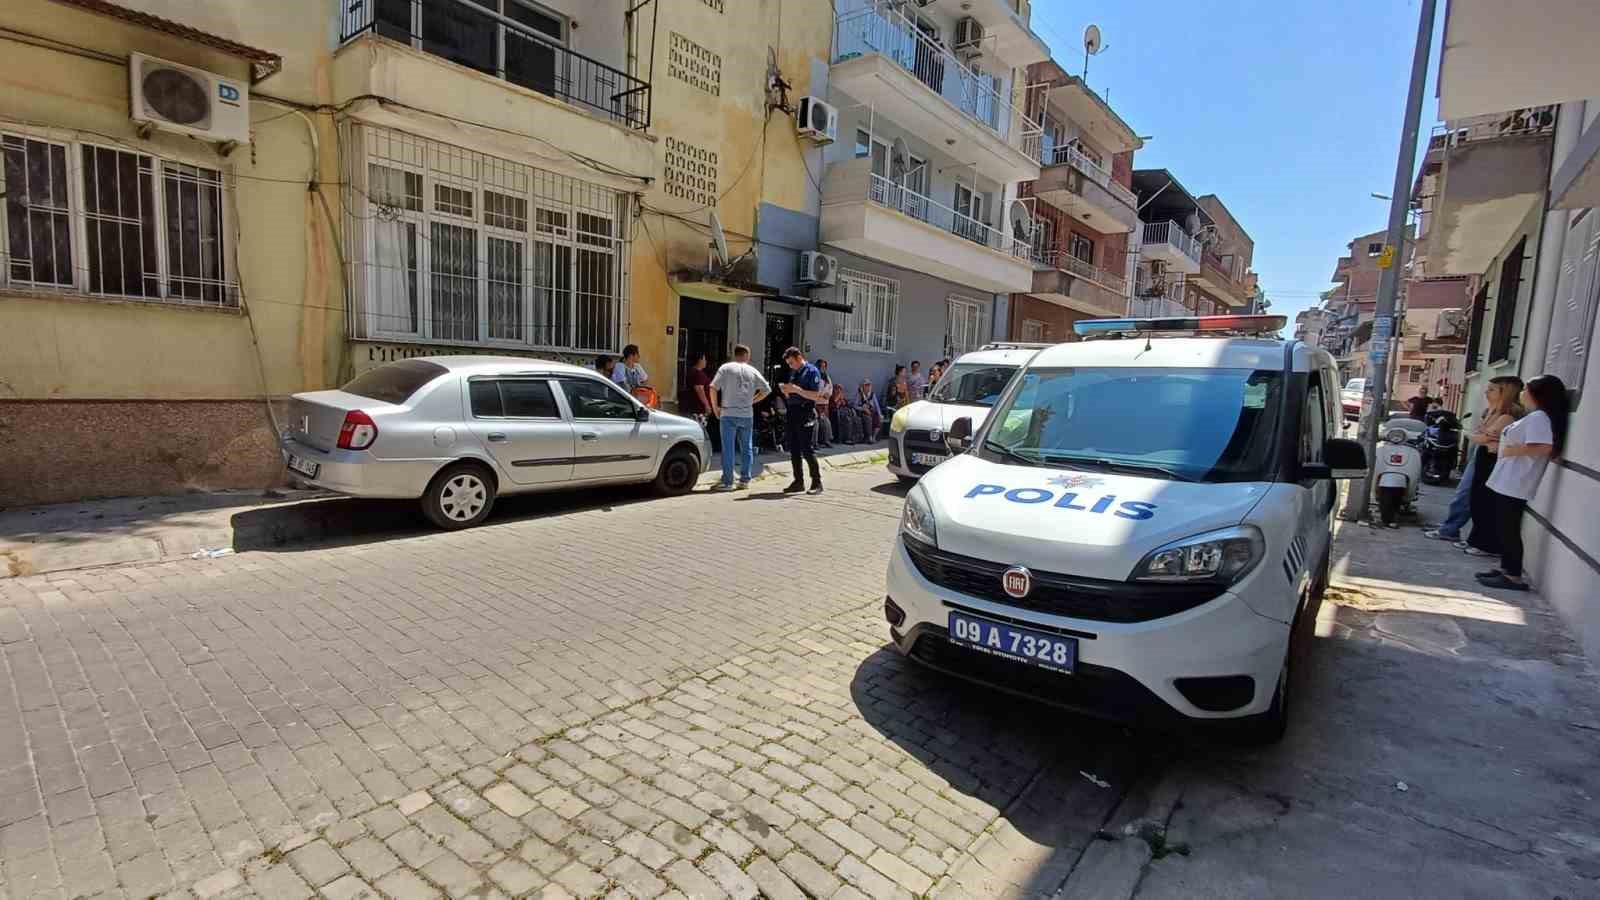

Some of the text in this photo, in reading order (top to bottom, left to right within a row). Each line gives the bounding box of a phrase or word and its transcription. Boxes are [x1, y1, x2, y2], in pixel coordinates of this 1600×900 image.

[964, 484, 1158, 520] POLİS
[1008, 577, 1026, 591] FIAT
[955, 618, 1068, 665] 09 A 7328
